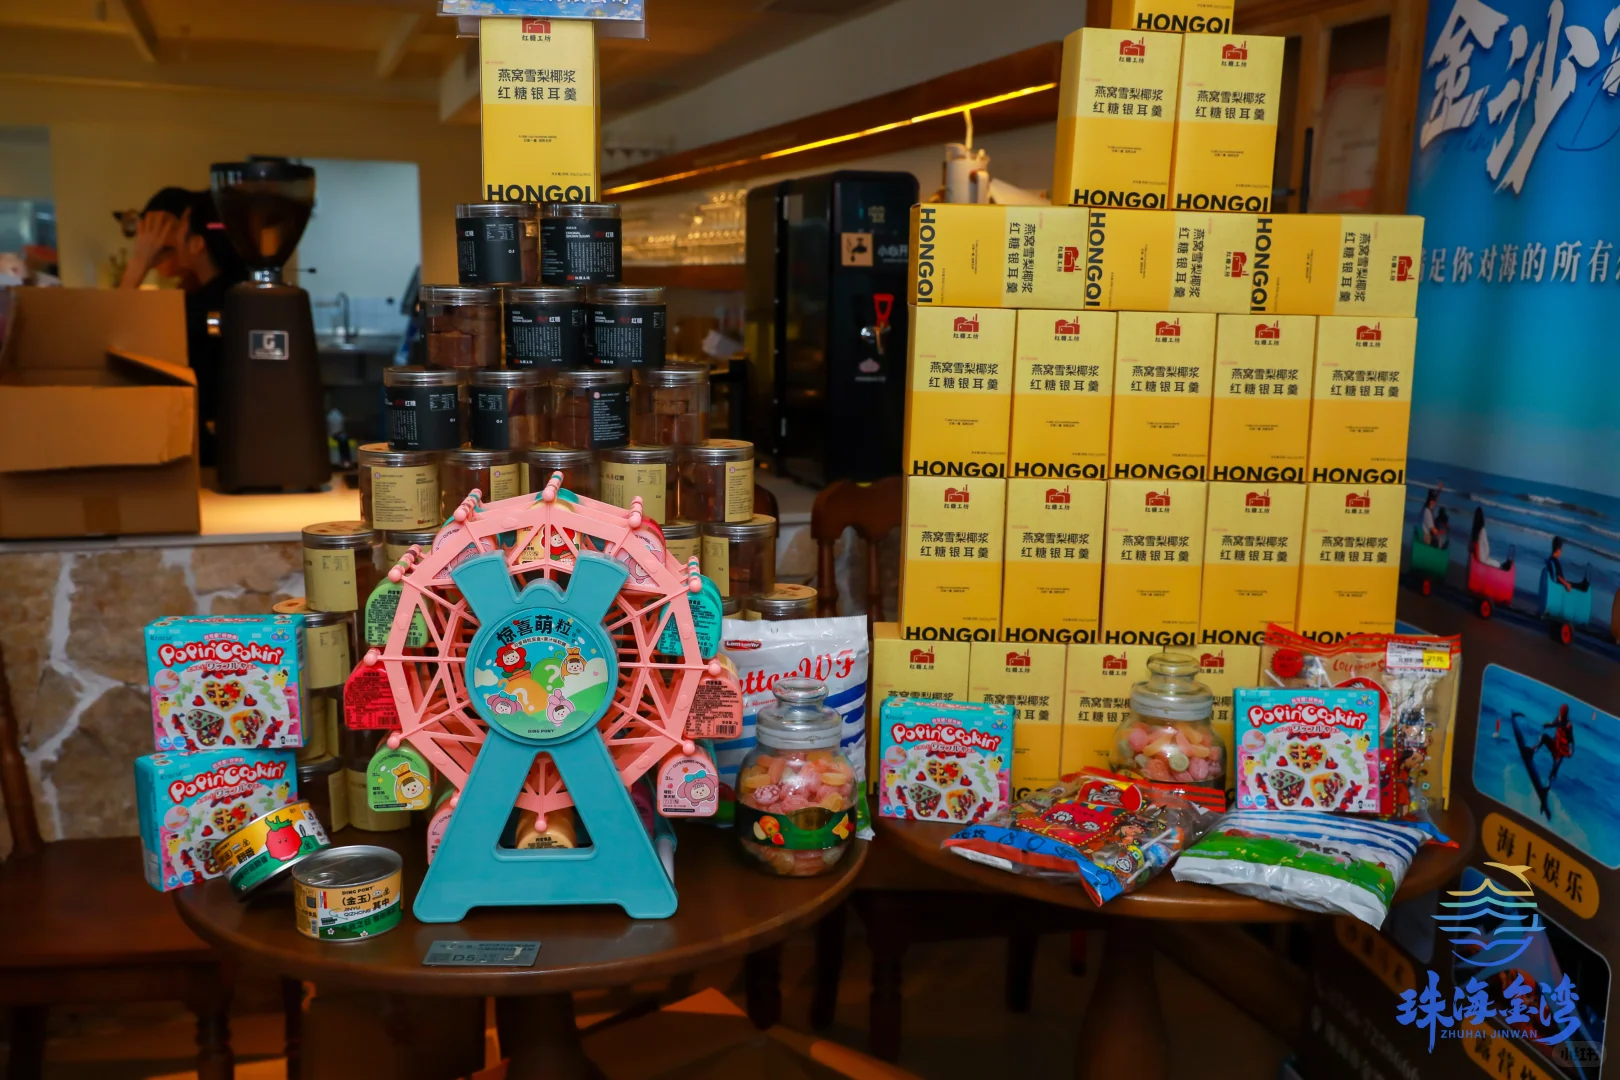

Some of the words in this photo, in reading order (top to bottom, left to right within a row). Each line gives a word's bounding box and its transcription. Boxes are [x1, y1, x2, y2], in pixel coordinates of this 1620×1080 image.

[1137, 13, 1230, 34] HONGQI
[498, 69, 576, 83] 燕窝雪梨椰浆
[498, 87, 576, 101] 红糖银耳羹
[1095, 86, 1163, 101] 燕窝雪梨椰浆
[1197, 90, 1266, 105] 燕窝雪梨椰浆
[1093, 102, 1162, 117] 红糖银耳羹
[1196, 107, 1264, 120] 红糖银耳羹
[487, 184, 591, 202] HONGQI
[1074, 189, 1165, 209] HONGQI
[1177, 194, 1268, 212] HONGQI
[918, 209, 936, 303] HONGQI
[1006, 223, 1021, 293] 红糖银耳羹
[1022, 224, 1035, 293] 燕窝雪梨椰浆
[1085, 213, 1106, 306] HONGQI
[1174, 228, 1190, 297] 红糖银耳羹
[1189, 229, 1205, 297] 燕窝雪梨椰浆
[1419, 240, 1620, 284] 足你对海的所有
[1251, 218, 1273, 311] HONGQI
[1339, 233, 1356, 302] 红糖银耳羹
[1355, 233, 1370, 302] 燕窝雪梨椰浆
[930, 362, 998, 374] 燕窝雪梨椰浆
[1032, 364, 1099, 376] 燕窝雪梨椰浆
[1132, 366, 1199, 378] 燕窝雪梨椰浆
[1231, 368, 1298, 380] 燕窝雪梨椰浆
[929, 377, 998, 390] 红糖银耳羹
[1332, 370, 1399, 382] 燕窝雪梨椰浆
[1030, 380, 1098, 391] 红糖银耳羹
[1131, 380, 1199, 393] 红糖银耳羹
[1230, 384, 1298, 396] 红糖银耳羹
[1330, 385, 1399, 397] 红糖银耳羹
[913, 460, 1005, 478] HONGQI
[1014, 463, 1105, 478] HONGQI
[1115, 464, 1205, 481] HONGQI
[1213, 466, 1303, 482] HONGQI
[1313, 467, 1403, 484] HONGQI
[922, 531, 988, 543] 燕窝雪梨椰浆
[1023, 533, 1089, 544] 燕窝雪梨椰浆
[1122, 535, 1189, 547] 燕窝雪梨椰浆
[1222, 535, 1288, 547] 燕窝雪梨椰浆
[1322, 537, 1388, 548] 燕窝雪梨椰浆
[921, 546, 988, 559] 红糖银耳羹
[1021, 547, 1089, 559] 红糖银耳羹
[1121, 550, 1189, 562] 红糖银耳羹
[1220, 550, 1287, 562] 红糖银耳羹
[1320, 551, 1387, 563] 红糖银耳羹
[496, 614, 572, 645] 惊喜萌粒
[906, 626, 996, 642] HONGQI
[1006, 628, 1095, 643] HONGQI
[1106, 630, 1195, 646] HONGQI
[1497, 826, 1583, 903] 海上娱乐
[373, 898, 390, 910] 其中
